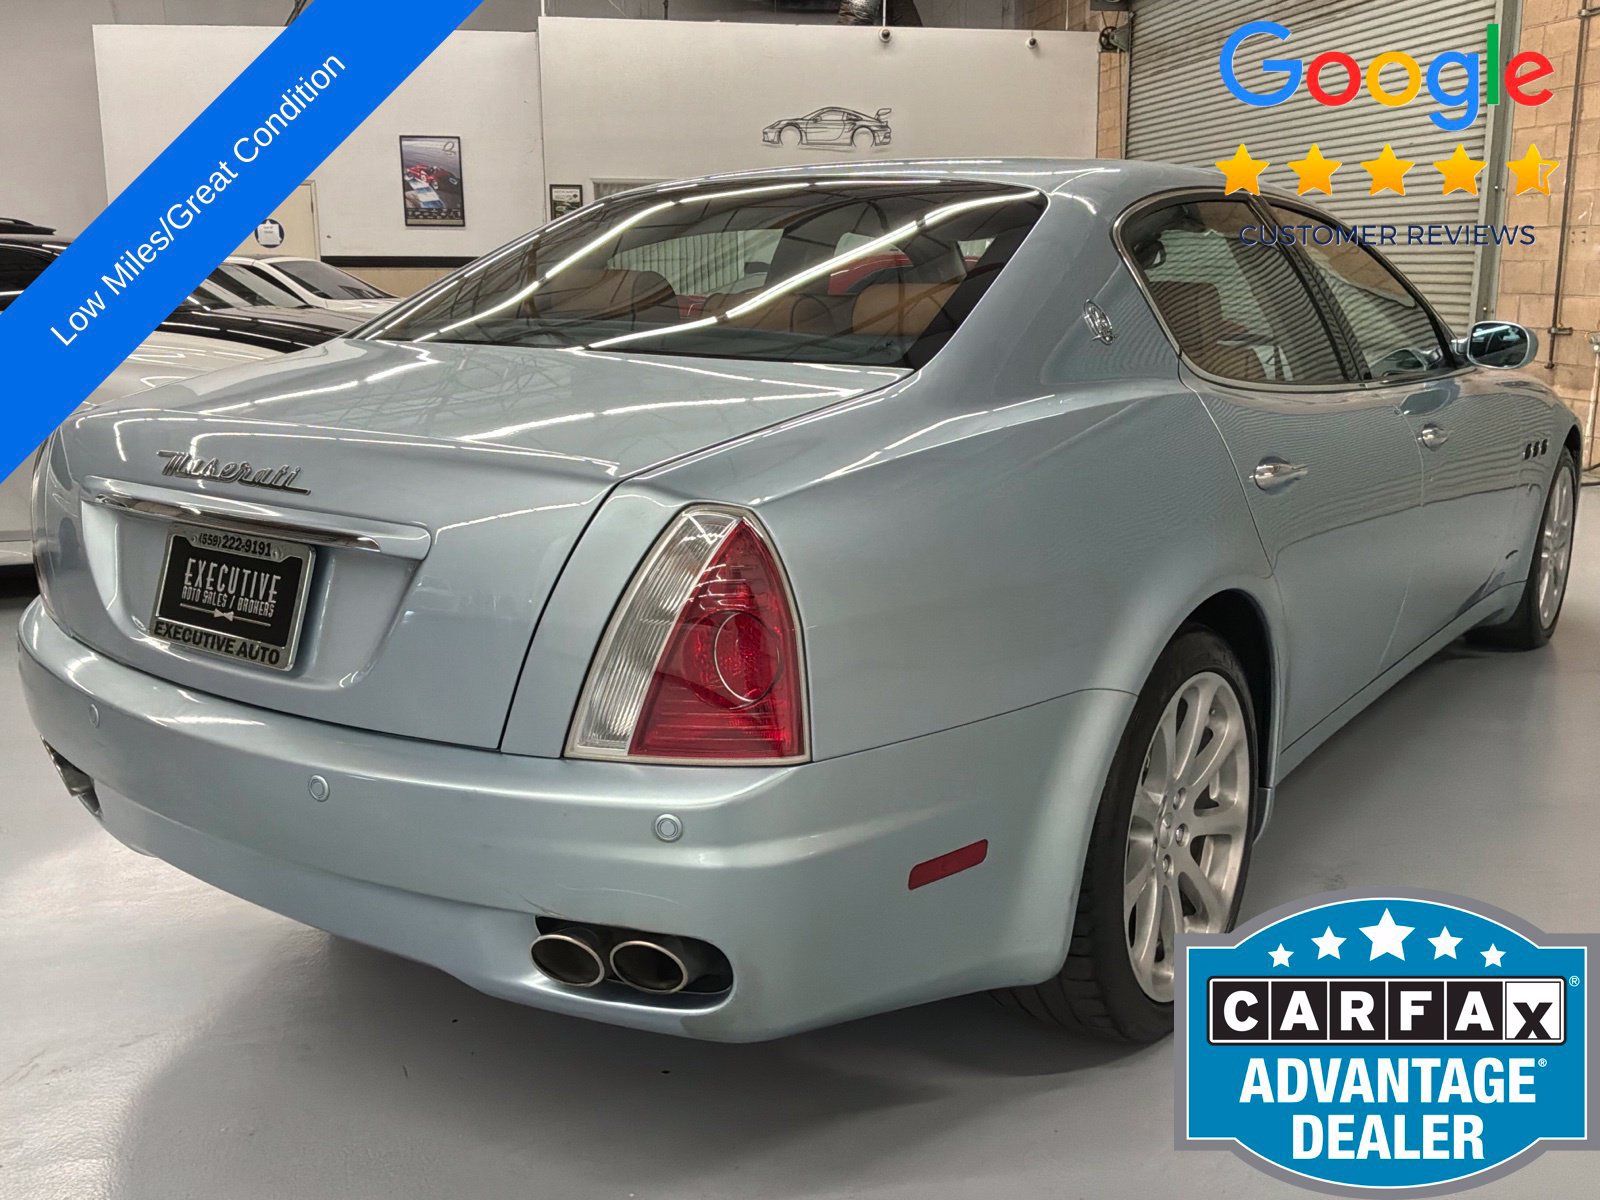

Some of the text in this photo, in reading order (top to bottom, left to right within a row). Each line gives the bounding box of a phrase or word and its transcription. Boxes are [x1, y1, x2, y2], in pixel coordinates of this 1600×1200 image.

[181, 585, 201, 602] AUTO
[202, 589, 228, 608] SALES
[236, 596, 275, 618] BROKERS
[184, 557, 281, 604] EXECUTIVE
[154, 621, 280, 665] EXECUTIVE AUTO
